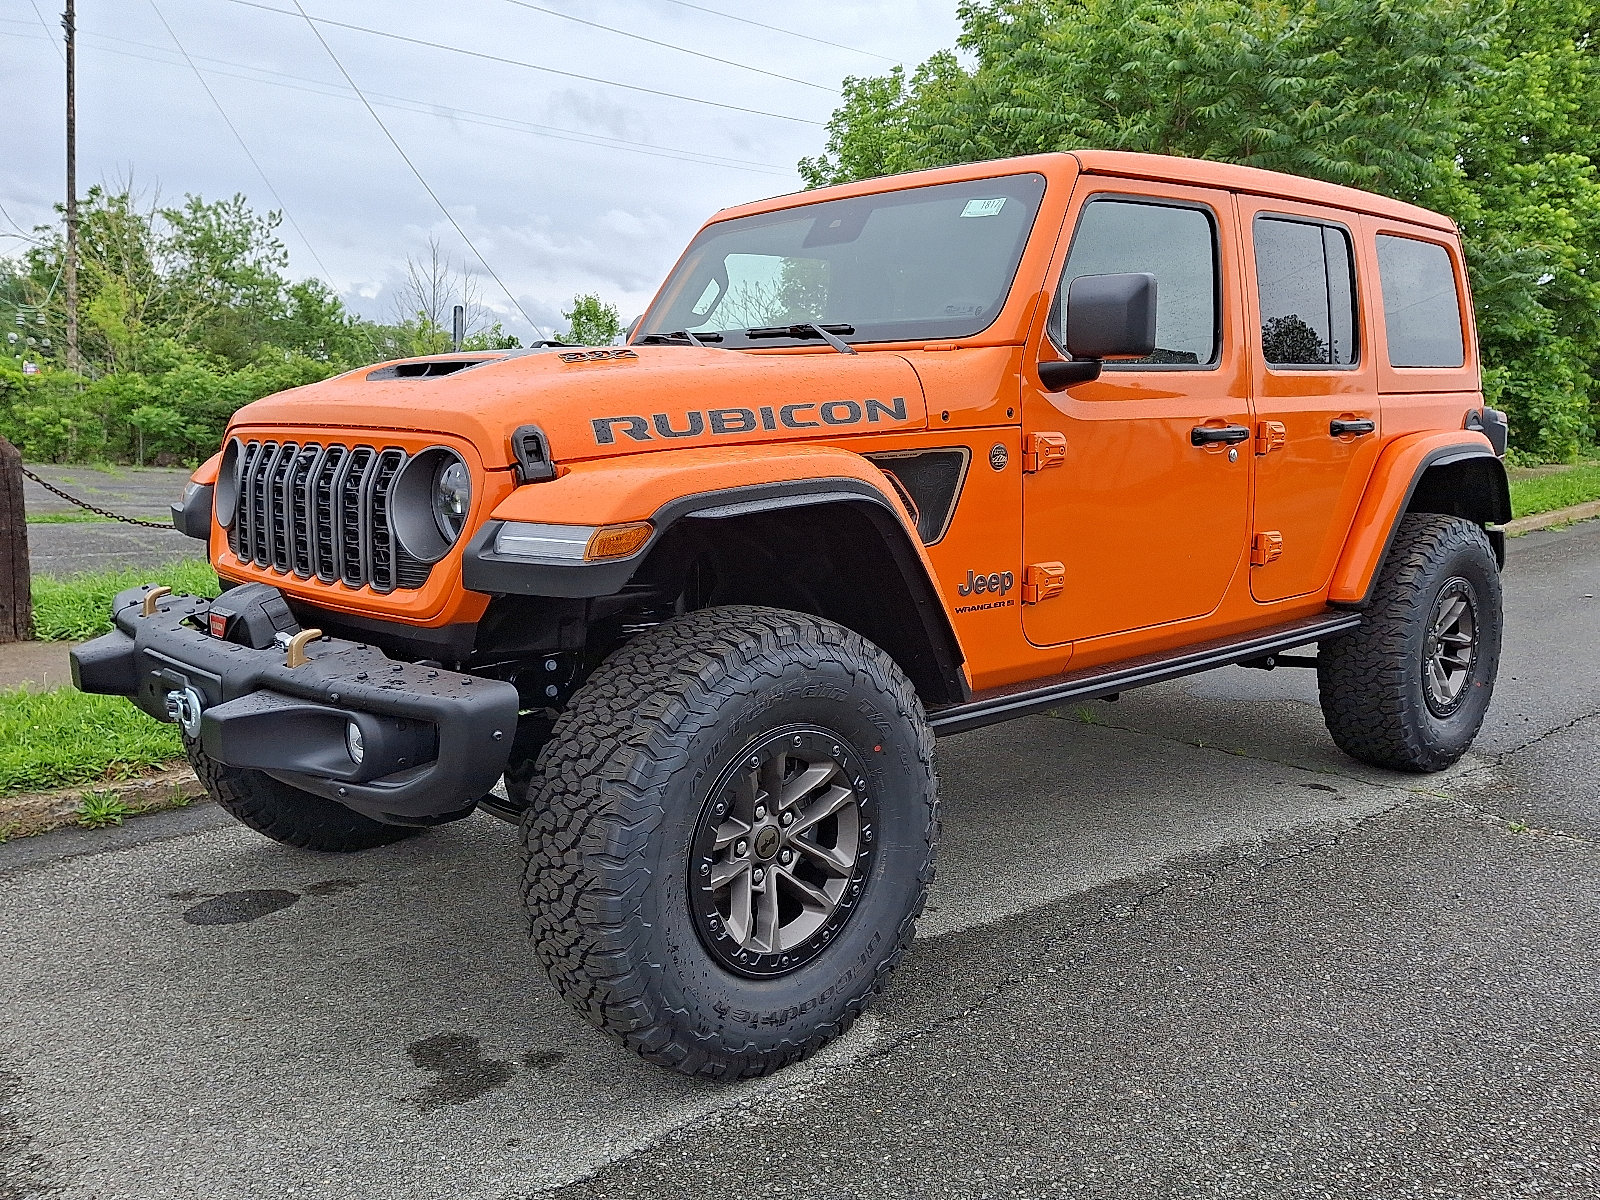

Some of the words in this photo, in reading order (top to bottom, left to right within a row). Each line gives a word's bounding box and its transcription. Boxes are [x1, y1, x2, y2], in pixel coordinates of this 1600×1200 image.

[591, 397, 908, 445] RUBICON
[957, 569, 1014, 597] Jeep
[954, 600, 1006, 614] WRANGLER
